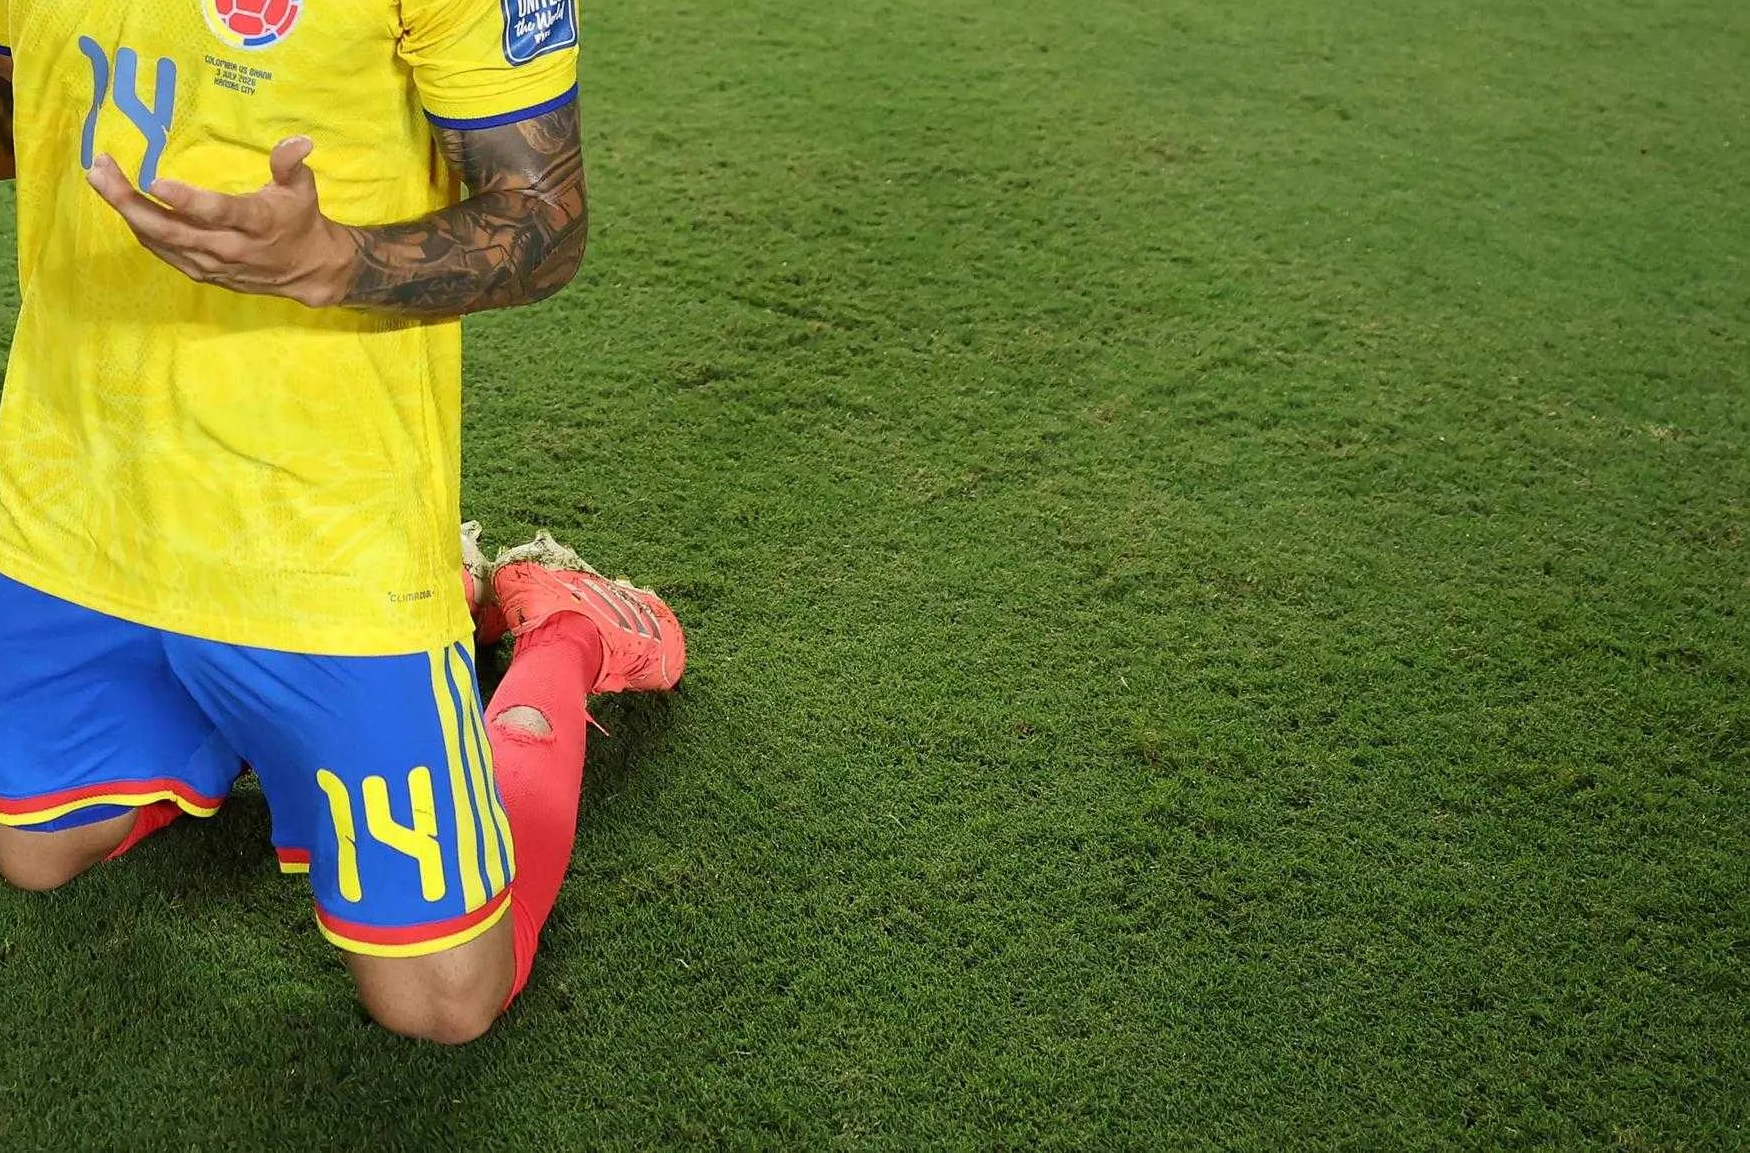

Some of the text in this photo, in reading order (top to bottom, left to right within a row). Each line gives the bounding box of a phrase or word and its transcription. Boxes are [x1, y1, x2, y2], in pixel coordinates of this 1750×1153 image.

[514, 17, 536, 37] the
[534, 0, 565, 31] World
[78, 35, 177, 192] 14
[240, 85, 256, 96] CITY
[316, 766, 446, 902] 14
